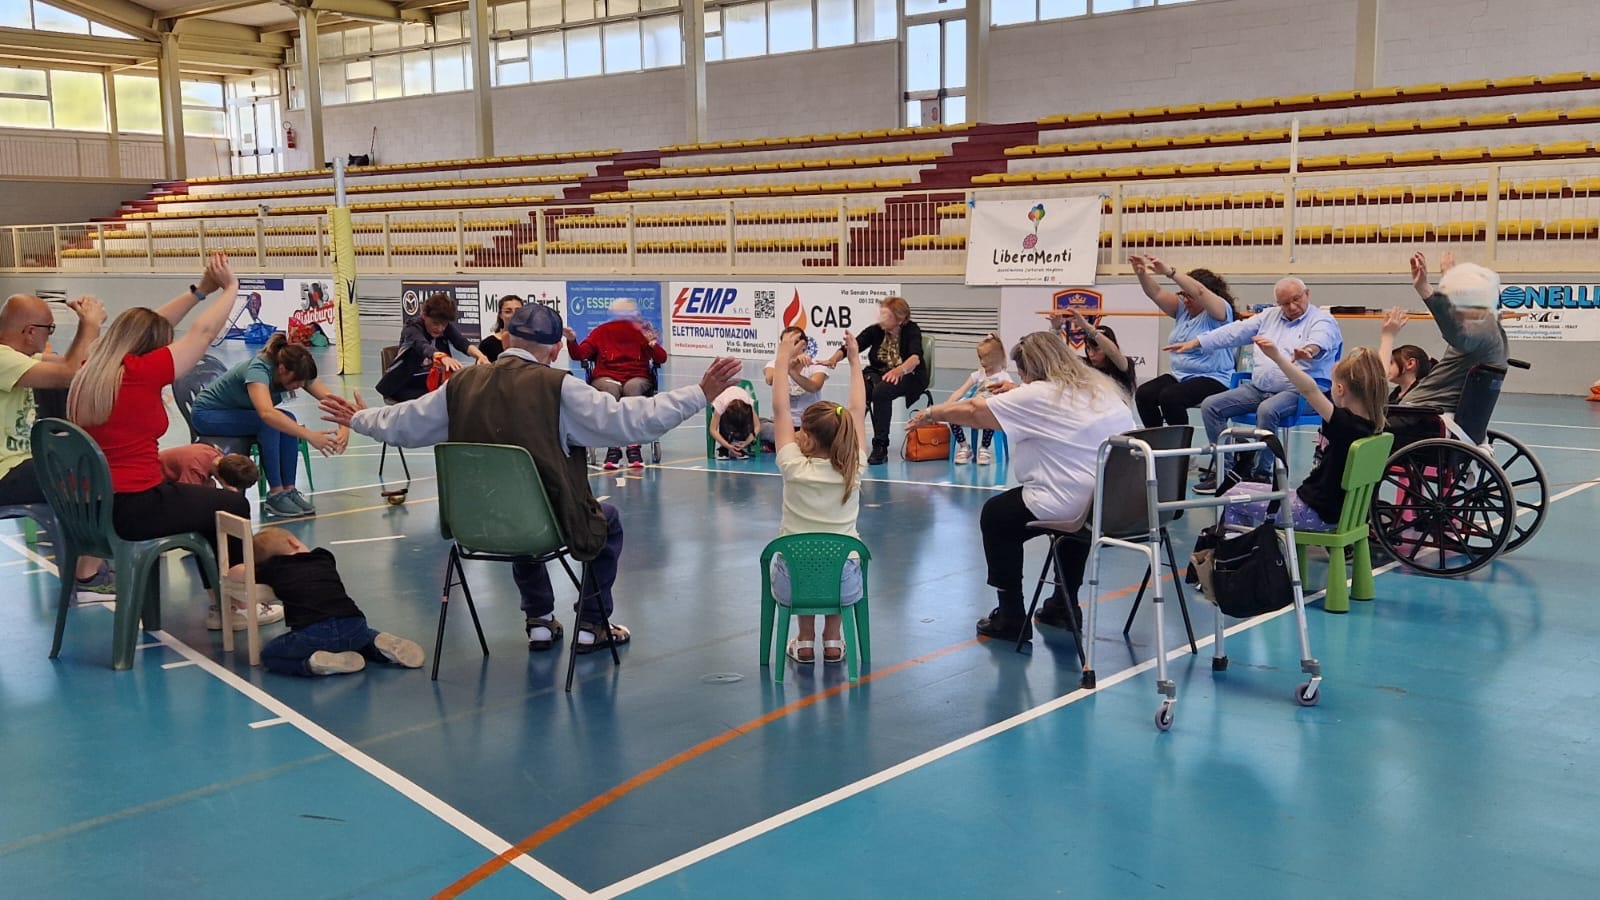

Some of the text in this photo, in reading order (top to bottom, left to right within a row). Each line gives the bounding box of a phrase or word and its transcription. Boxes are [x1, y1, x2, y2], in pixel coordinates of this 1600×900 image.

[993, 248, 1072, 265] LiberaMenti
[686, 287, 738, 314] EMP
[811, 305, 852, 329] CAB
[672, 326, 758, 339] ELETTROAUTOMAZIONI
